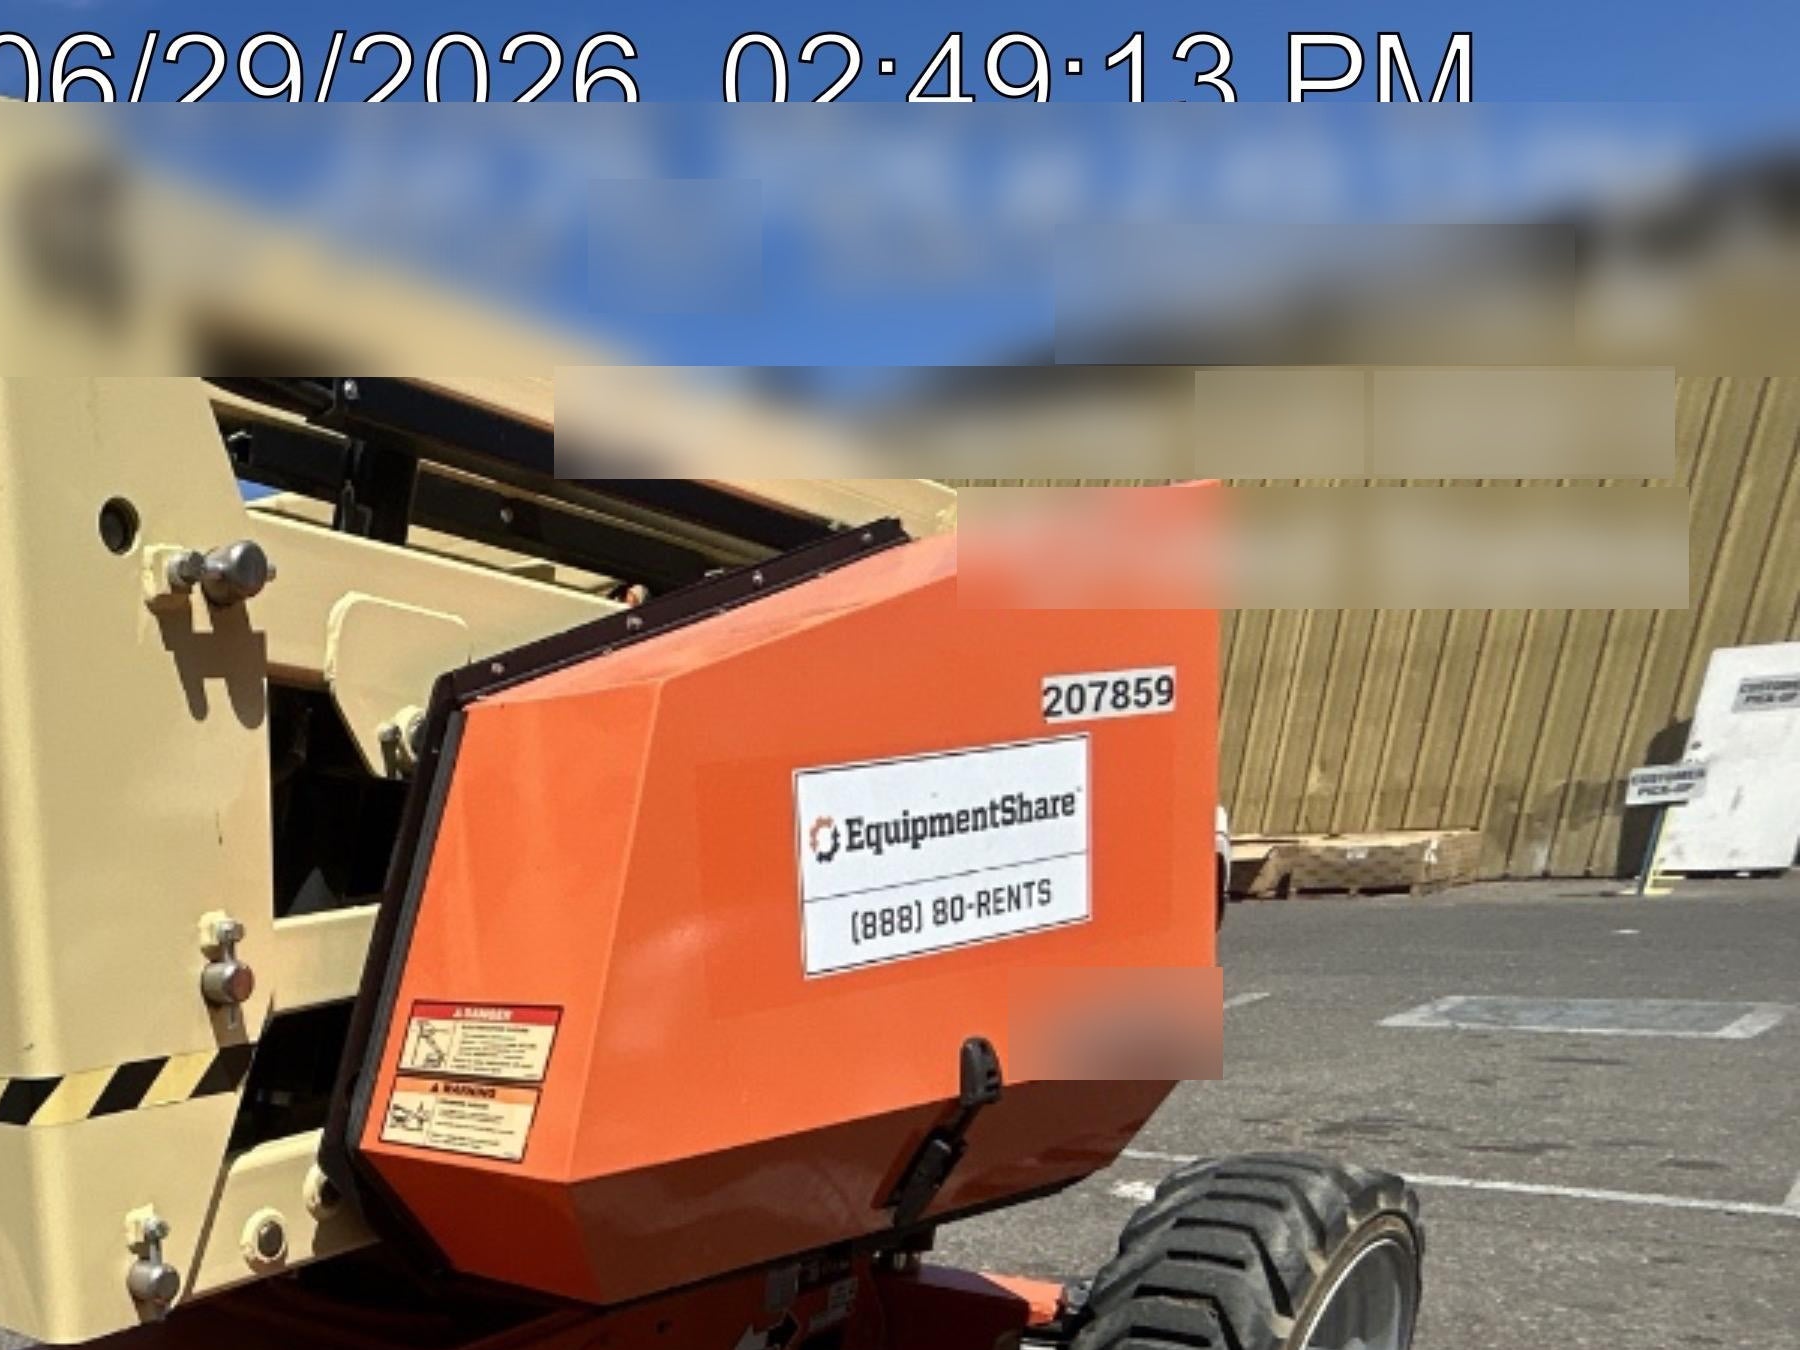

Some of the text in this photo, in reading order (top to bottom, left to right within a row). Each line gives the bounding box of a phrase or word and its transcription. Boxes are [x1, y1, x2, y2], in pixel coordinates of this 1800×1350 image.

[1043, 674, 1175, 718] 207859
[845, 791, 1075, 855] EquipmentShare
[851, 879, 1052, 945] (888) 80-RENTS
